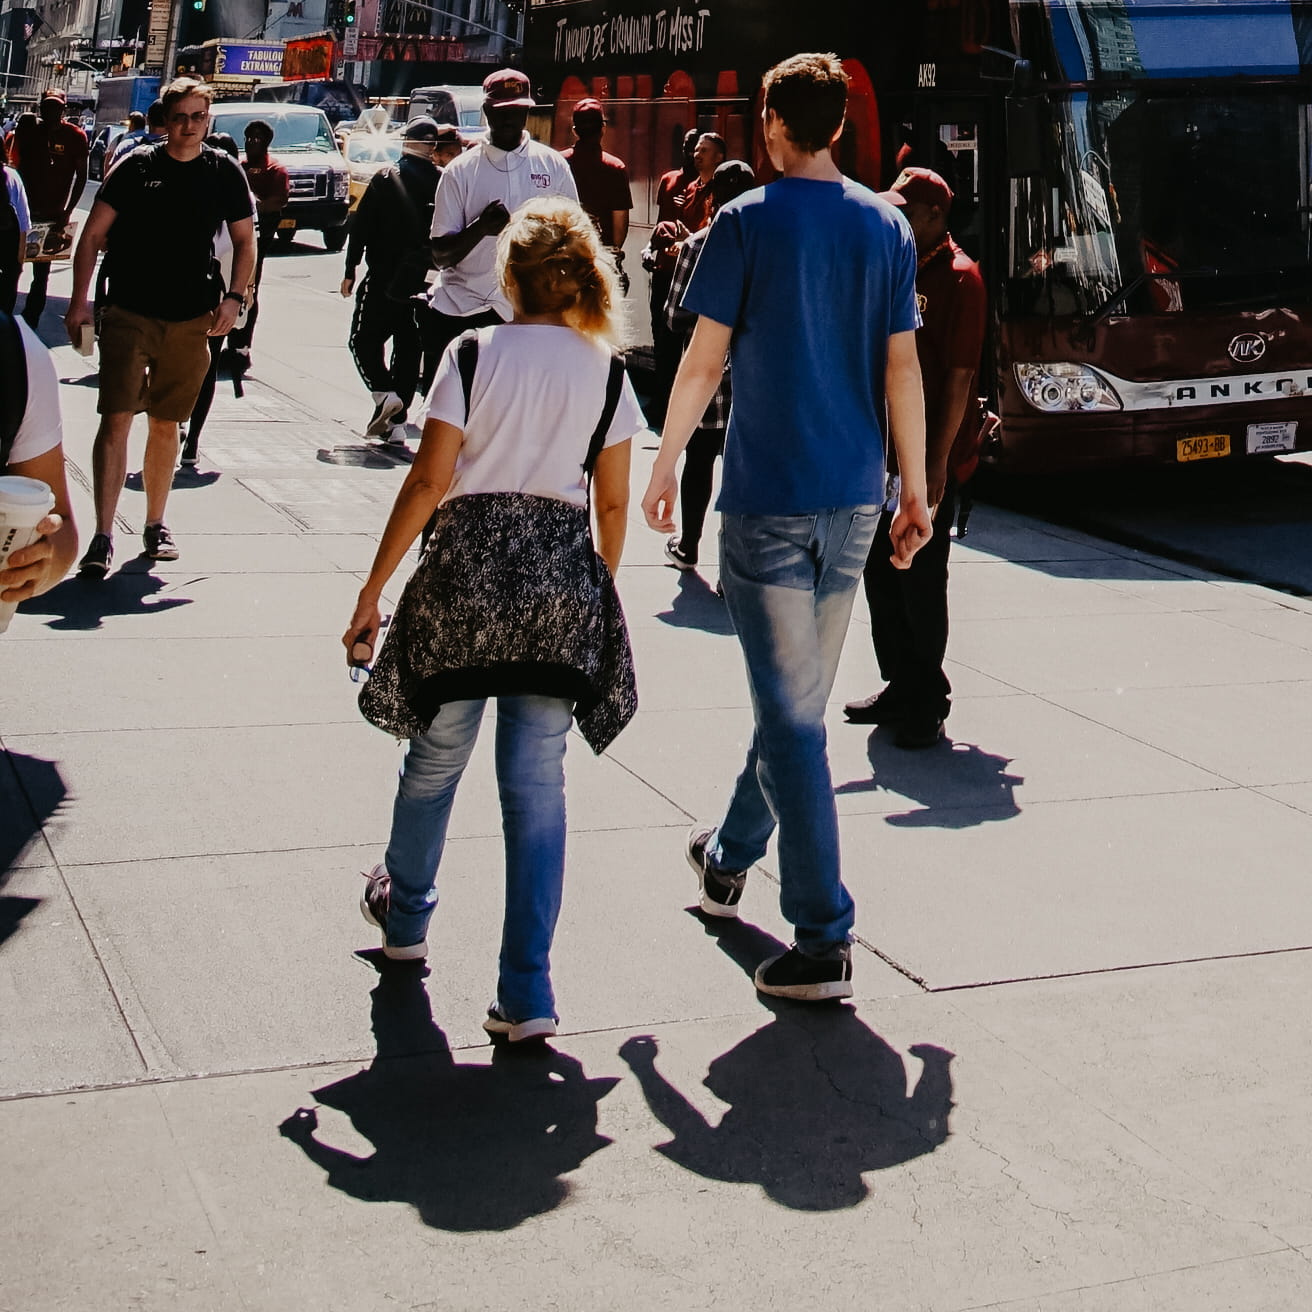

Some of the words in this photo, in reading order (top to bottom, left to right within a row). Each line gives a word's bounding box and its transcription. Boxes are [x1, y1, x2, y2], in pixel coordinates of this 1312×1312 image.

[554, 17, 568, 63] IT
[565, 25, 591, 64] WOULD
[592, 22, 608, 62] BE
[610, 13, 653, 56] CRIMINAL
[655, 9, 667, 51] TO
[669, 6, 694, 57] MISS
[696, 8, 711, 52] IT
[240, 60, 282, 73] EXTRAVAG
[918, 63, 936, 88] AK92
